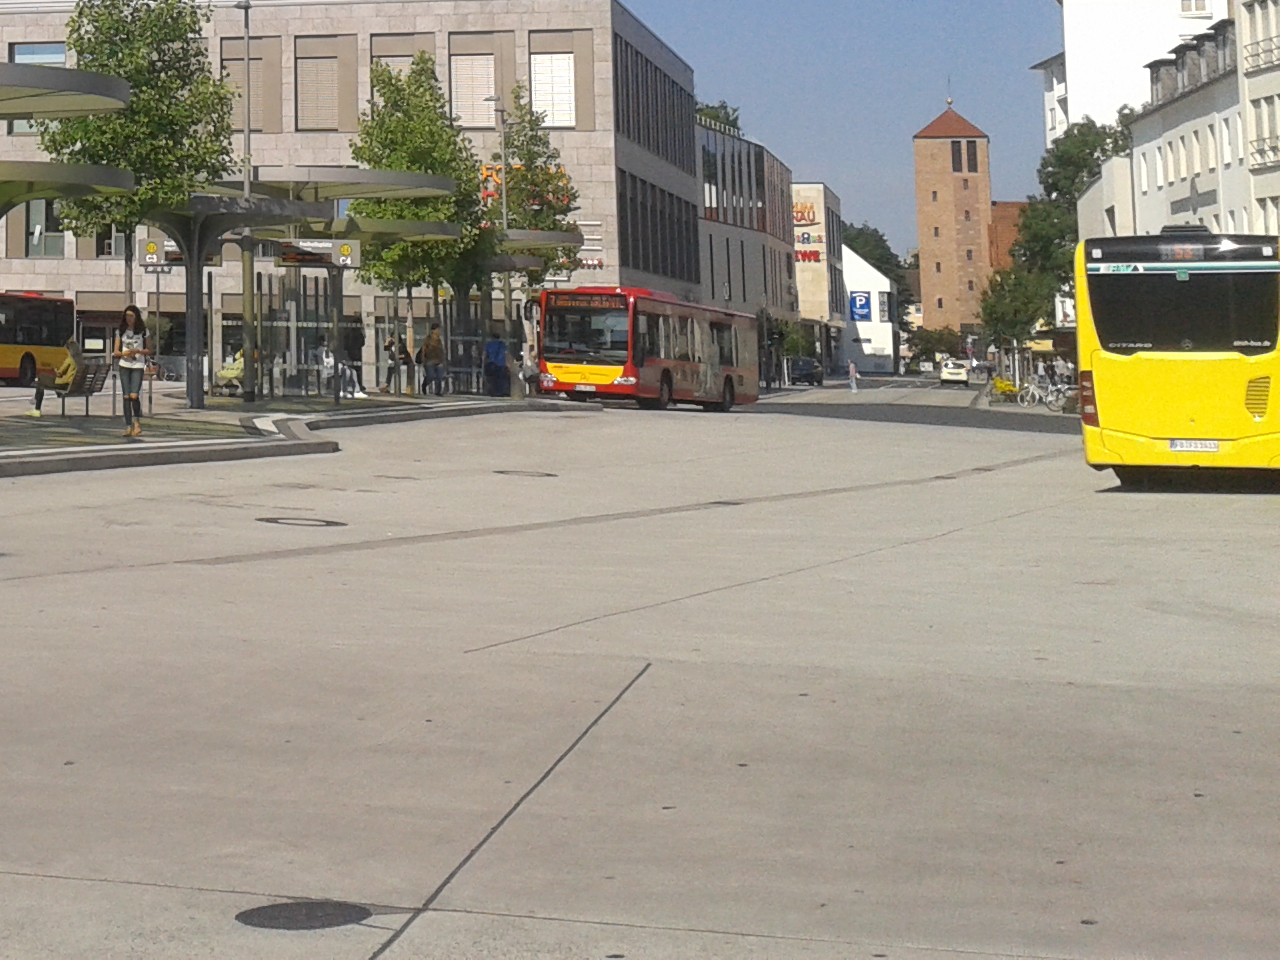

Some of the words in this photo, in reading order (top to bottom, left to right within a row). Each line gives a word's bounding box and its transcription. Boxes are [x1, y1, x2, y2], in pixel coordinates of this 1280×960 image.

[145, 253, 158, 263] C3
[339, 256, 352, 265] C4
[855, 296, 866, 309] P
